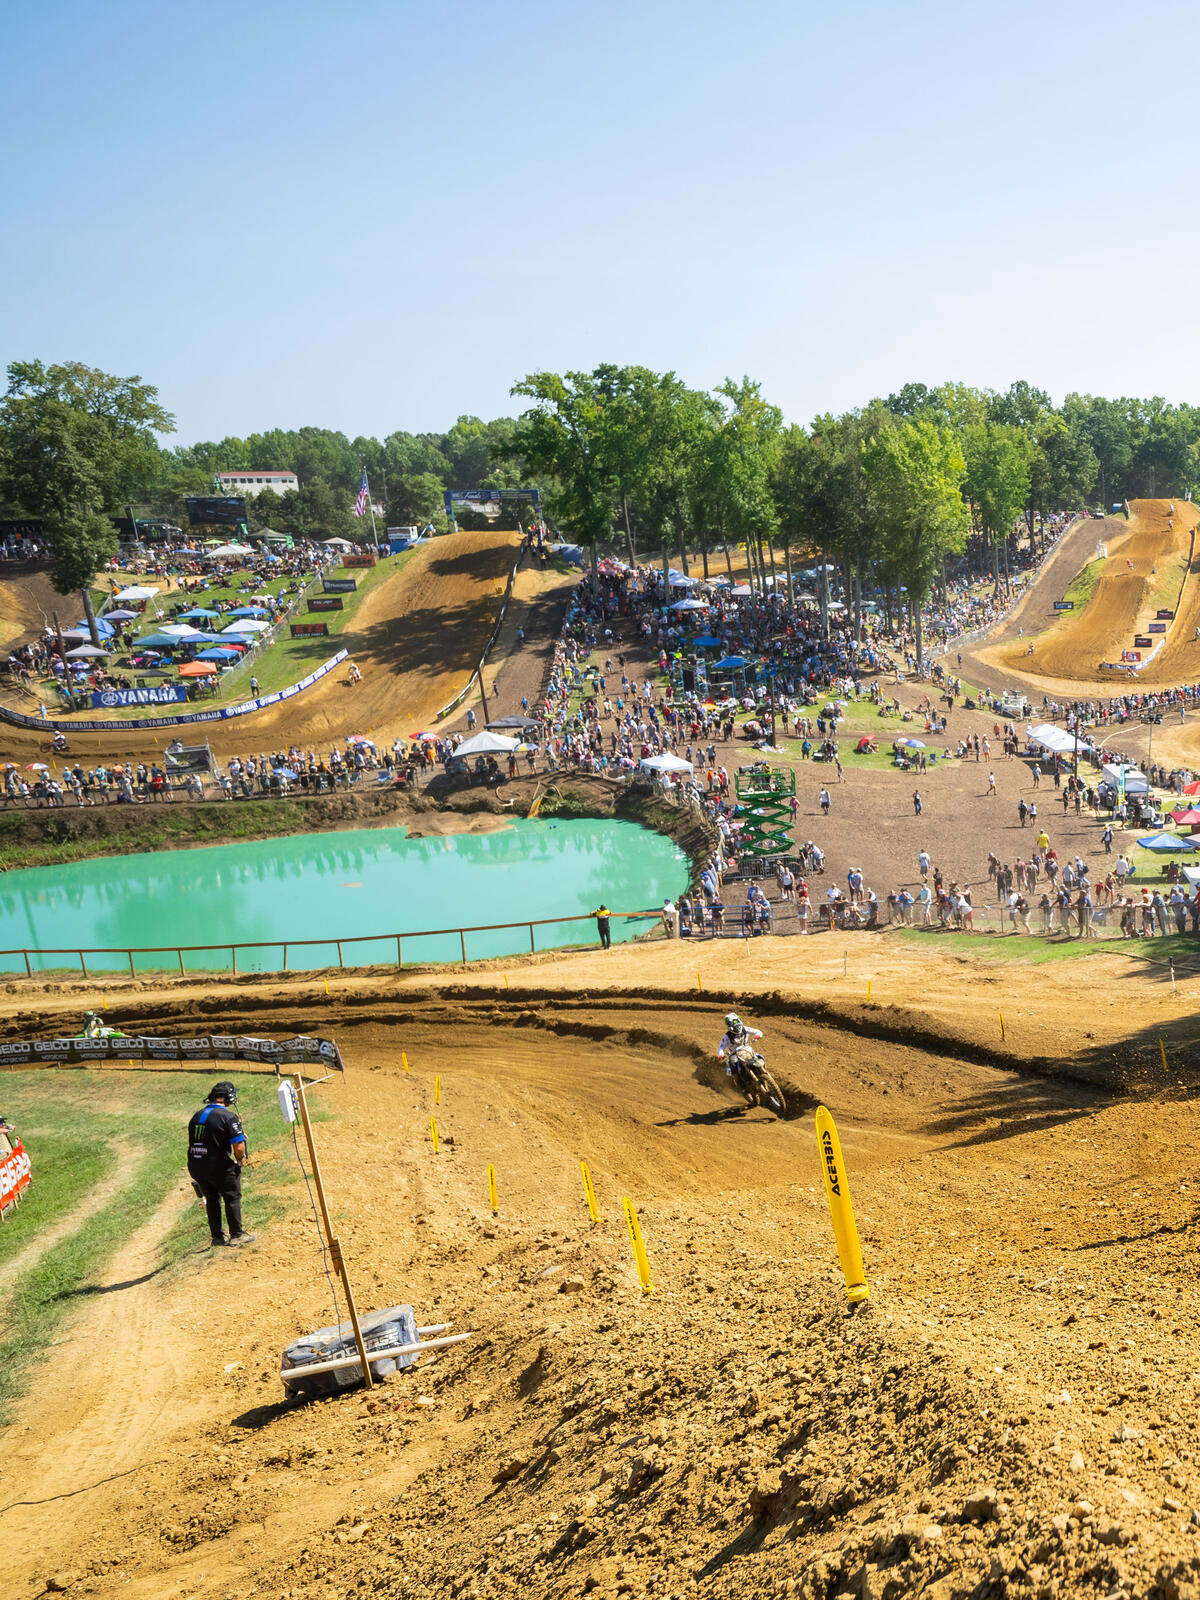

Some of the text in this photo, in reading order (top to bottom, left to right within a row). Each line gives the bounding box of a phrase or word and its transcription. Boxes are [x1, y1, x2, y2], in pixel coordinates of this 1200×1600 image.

[118, 688, 178, 704] YAMAHA
[192, 711, 221, 720] YAMAHA
[0, 1043, 31, 1054] EICO
[34, 1041, 70, 1051] GEICO
[74, 1039, 109, 1050] GEICO
[111, 1038, 144, 1049] GEICO
[148, 1039, 178, 1049] GEICO
[179, 1038, 210, 1049] GEICO
[212, 1038, 235, 1049] GEICO
